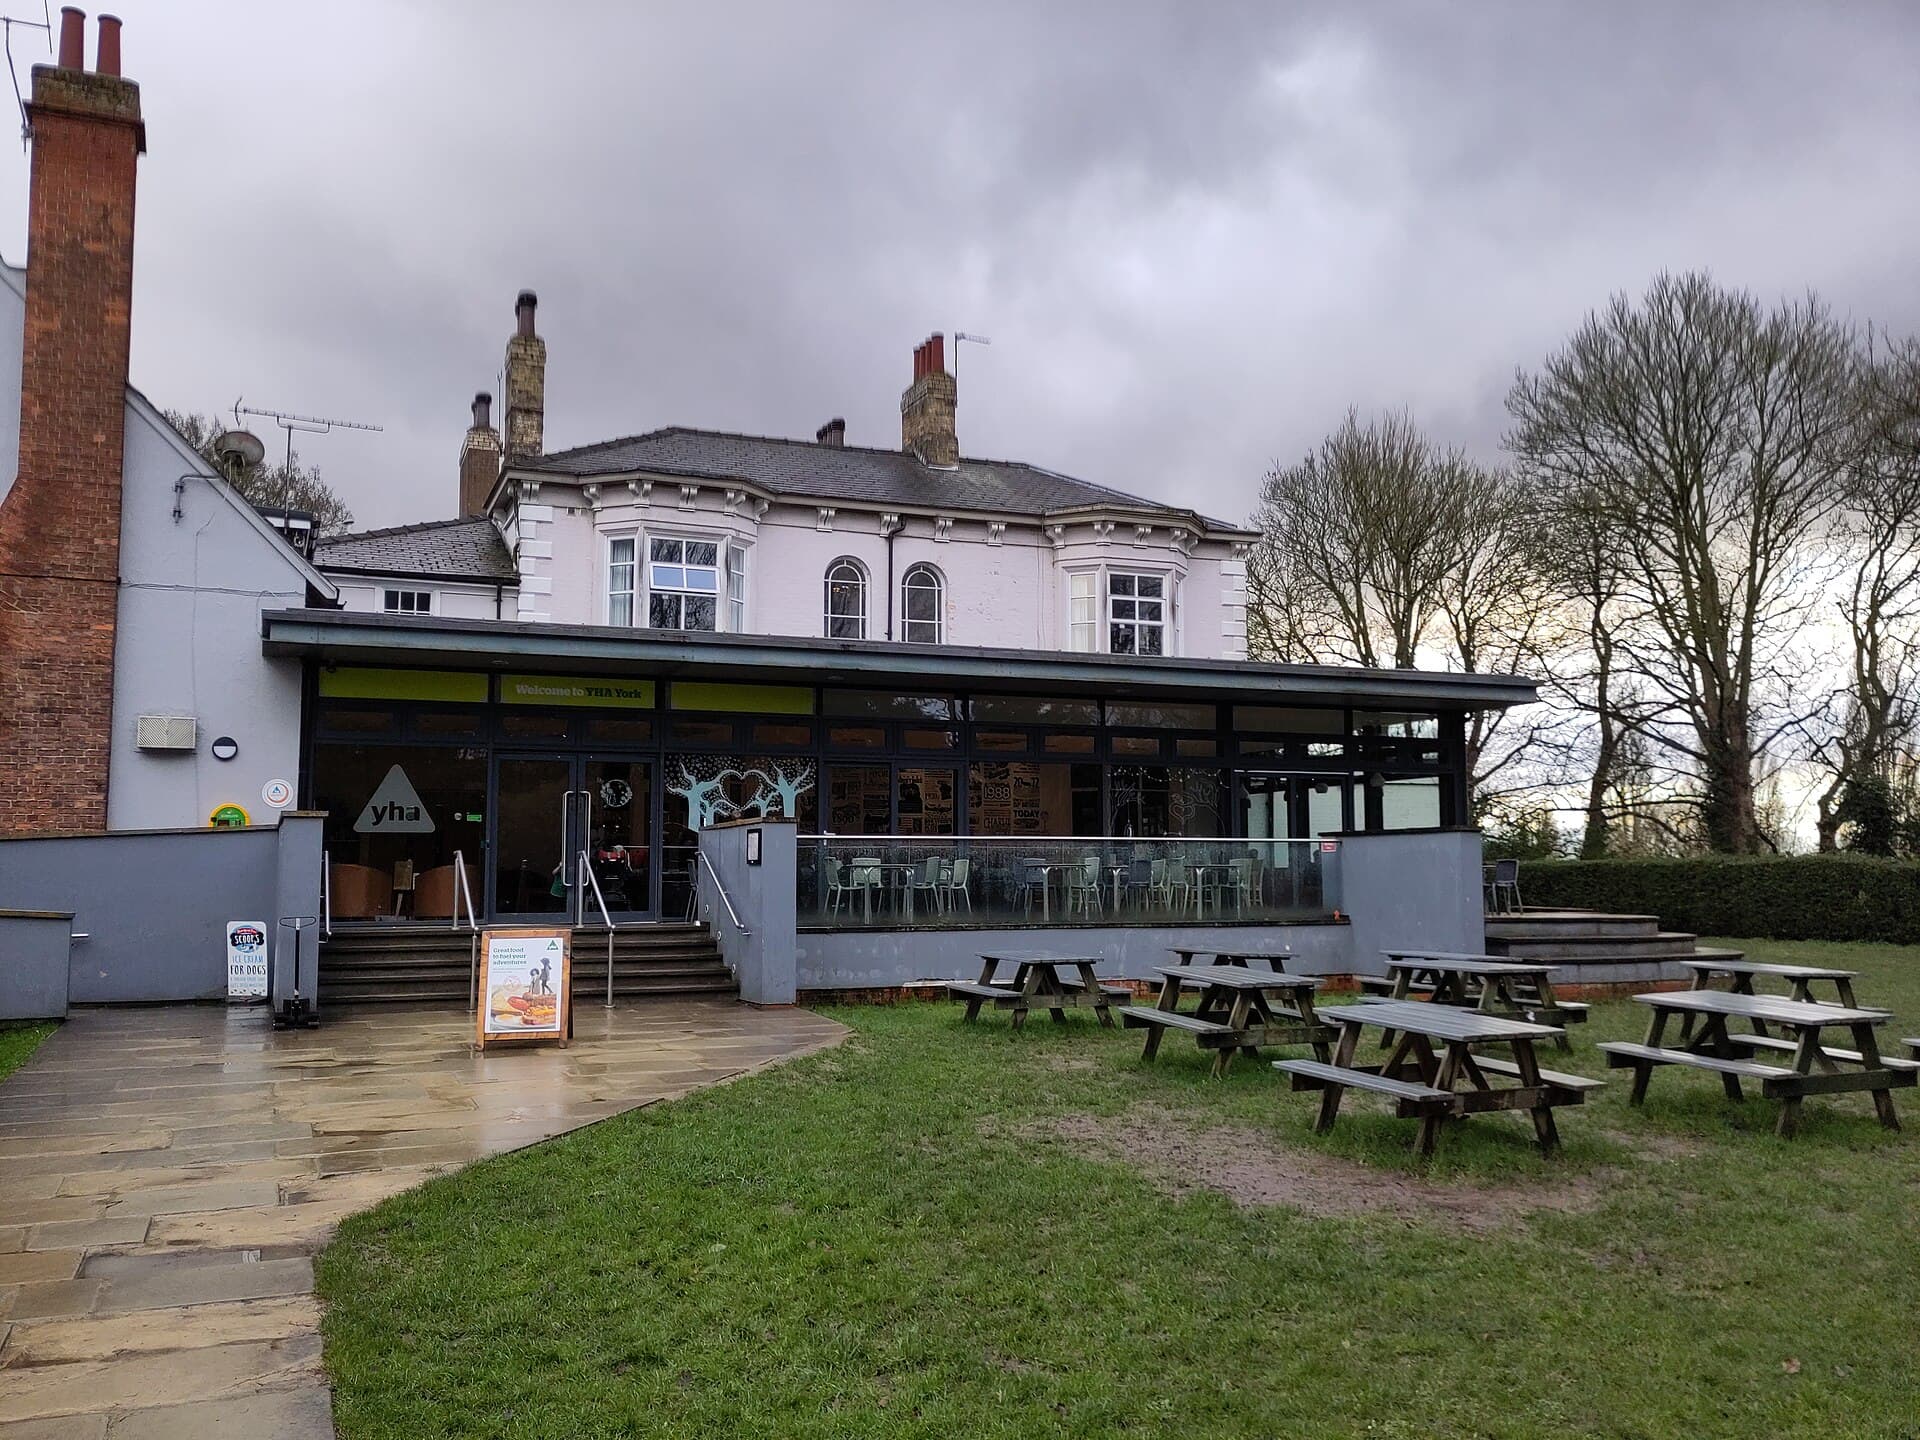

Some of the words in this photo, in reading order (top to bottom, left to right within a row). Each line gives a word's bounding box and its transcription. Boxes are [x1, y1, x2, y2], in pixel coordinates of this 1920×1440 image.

[516, 684, 571, 696] Welcome
[572, 687, 584, 696] to
[585, 687, 613, 698] YHA
[614, 688, 642, 699] York
[984, 786, 1010, 799] 1988
[371, 801, 420, 826] yha
[1013, 810, 1040, 818] TODAY
[230, 965, 245, 975] FOR
[246, 965, 266, 975] DOGS
